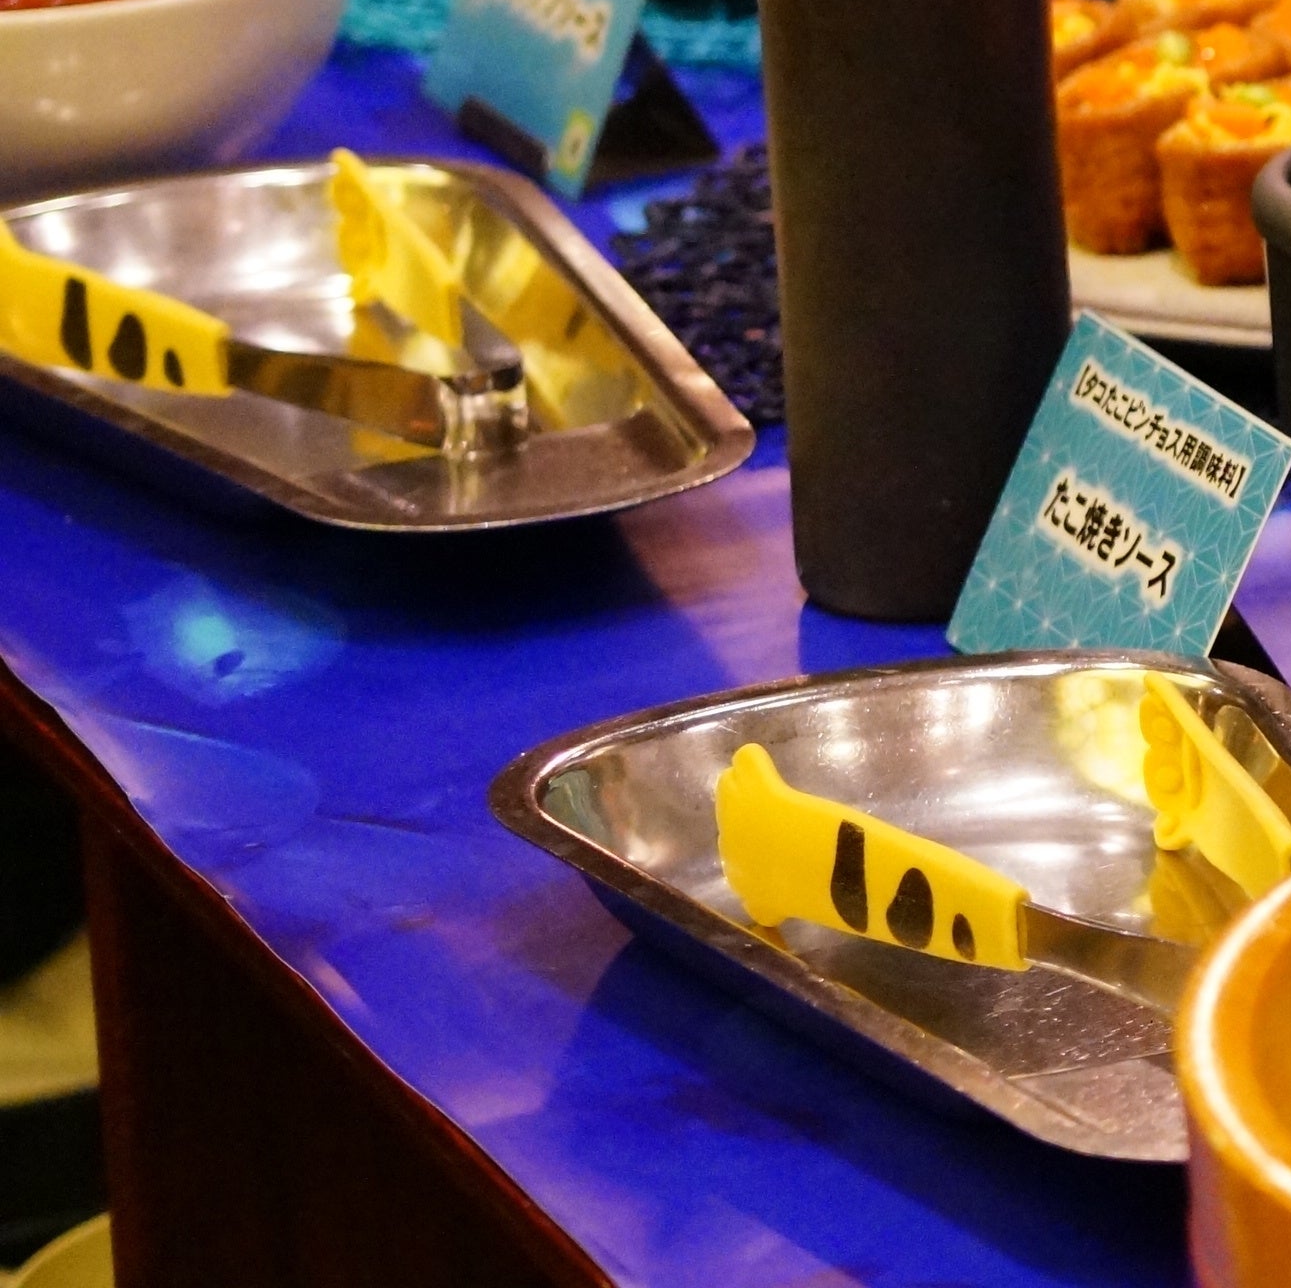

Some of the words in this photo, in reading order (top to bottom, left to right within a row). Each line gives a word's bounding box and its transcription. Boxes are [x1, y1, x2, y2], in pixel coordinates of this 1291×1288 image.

[1043, 477, 1176, 599] たこ焼きソース
